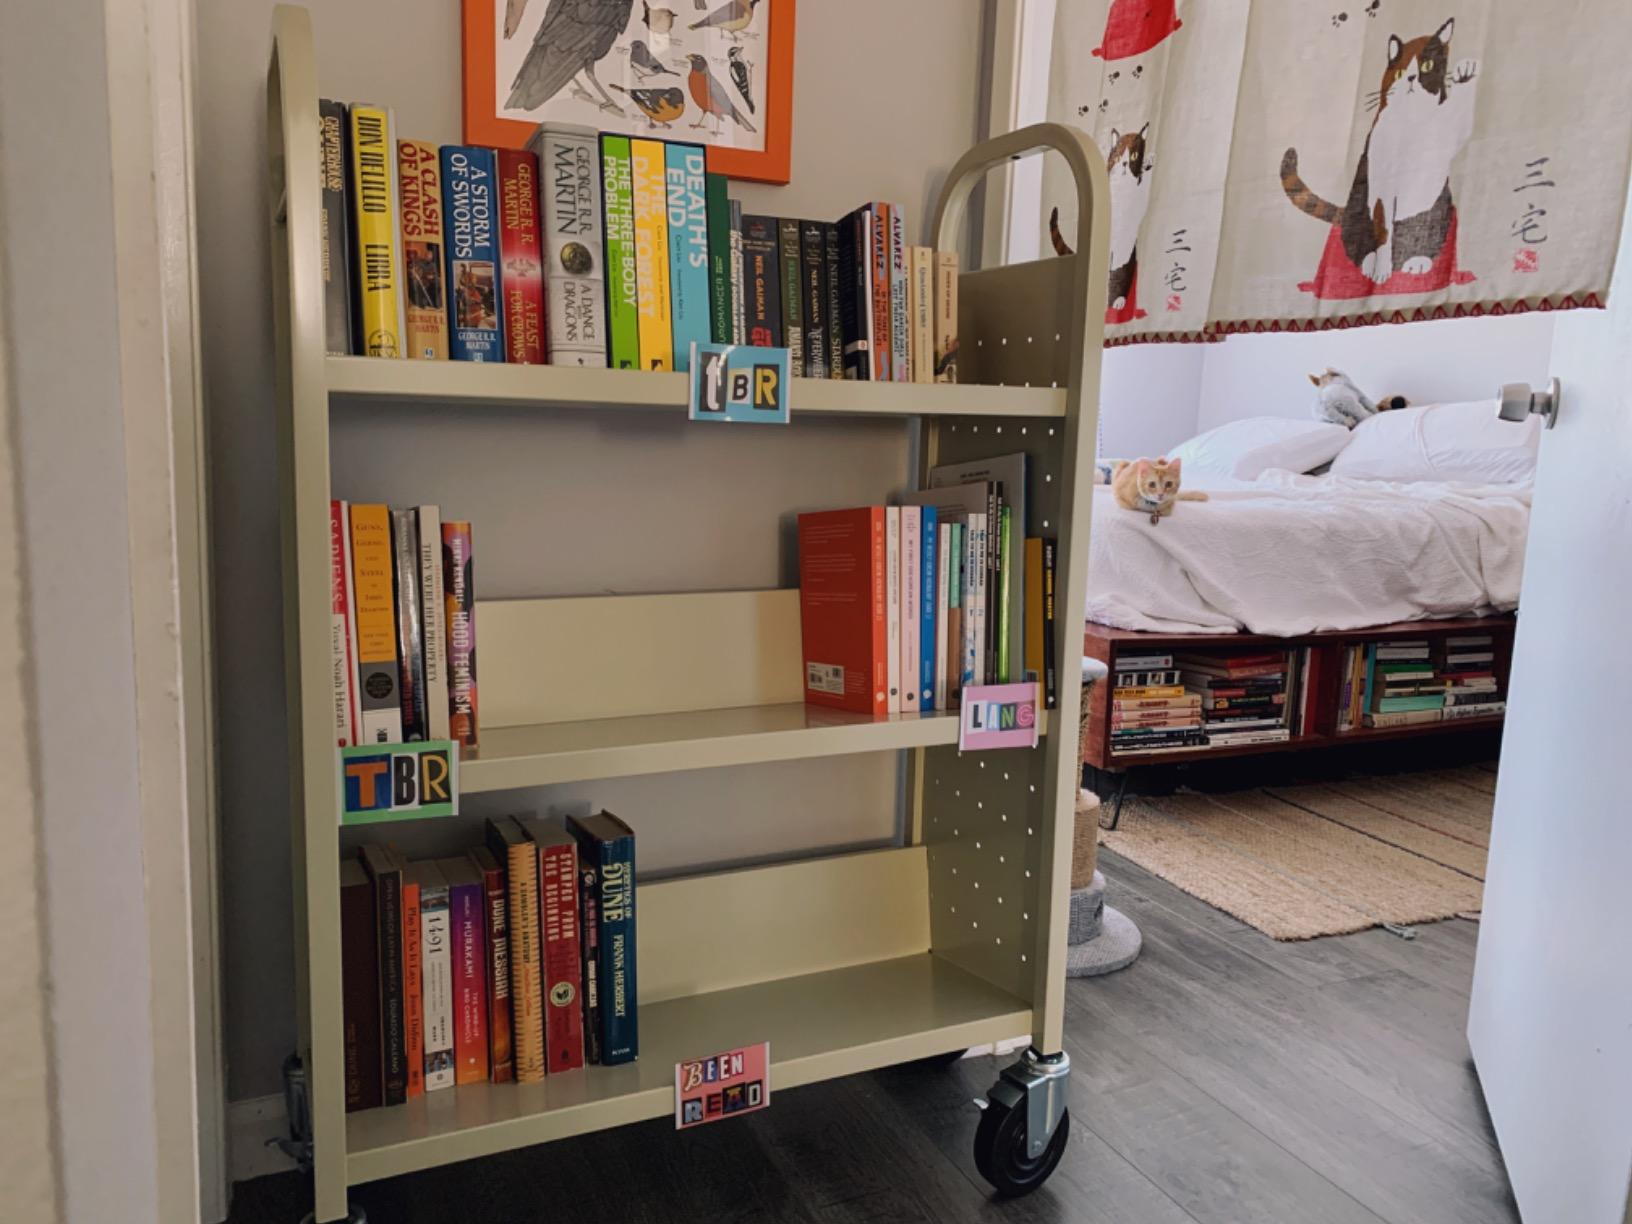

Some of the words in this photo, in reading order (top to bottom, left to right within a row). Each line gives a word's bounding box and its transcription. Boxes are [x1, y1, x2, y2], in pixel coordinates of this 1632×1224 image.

[358, 117, 383, 148] DON
[400, 143, 418, 170] OF
[420, 148, 436, 163] A
[451, 153, 468, 178] OF
[471, 166, 488, 180] A
[617, 158, 632, 190] THE
[360, 152, 387, 213] DELILLO
[518, 163, 533, 215] GEORGE
[554, 143, 577, 235] MARTIN
[575, 146, 591, 205] GEORGE
[632, 155, 651, 221] DARK
[650, 174, 666, 215] THE
[401, 175, 421, 236] KINGS
[421, 168, 439, 235] CLASH
[472, 184, 490, 248] STORM
[504, 178, 519, 229] MARTIN
[604, 155, 619, 240] PROBLEM
[667, 168, 686, 228] END
[685, 155, 707, 268] DEATH'S
[452, 180, 472, 258] SWORDS
[619, 198, 637, 308] THREE-BODY
[875, 216, 885, 270] ALVAREZ
[893, 216, 902, 270] ALVAREZ
[365, 244, 391, 292] LIBRA
[634, 228, 654, 317] FOREST
[755, 256, 764, 274] NEIL
[830, 264, 839, 285] NEIL
[511, 291, 523, 313] FOR
[525, 301, 536, 309] A
[581, 284, 592, 295] A
[755, 278, 765, 320] GAIMAN
[789, 283, 798, 320] GAIMAN
[526, 311, 539, 350] FEAST
[563, 281, 578, 341] DRAGONS
[582, 297, 595, 340] DANCE
[831, 289, 841, 333] GAIMAN
[512, 315, 526, 358] CROWS
[422, 543, 432, 570] THEY
[452, 538, 463, 563] MIKKI
[423, 574, 433, 602] WERE
[453, 566, 465, 604] KENDALL
[424, 607, 435, 628] HER
[452, 611, 470, 648] HOOD
[332, 624, 344, 655] Yuval
[426, 632, 437, 682] PROPERTY
[333, 659, 345, 688] Noah
[454, 652, 472, 714] FEMINISM
[335, 692, 347, 729] Harari
[972, 703, 1034, 729] LING
[345, 754, 448, 808] TBR
[545, 856, 558, 878] THE
[559, 854, 574, 902] STAMPED
[623, 862, 632, 905] HERETICS
[602, 863, 624, 923] DUNE
[406, 907, 417, 926] Play
[492, 900, 505, 933] DUNE
[545, 884, 560, 942] BEGINNING
[561, 910, 575, 940] FROM
[624, 907, 632, 919] OF
[425, 916, 444, 954] 1491
[463, 921, 474, 978] MURAKAMI
[613, 934, 624, 969] FRANK
[493, 938, 509, 1000] MESSIAH
[409, 994, 419, 1016] Joan
[614, 970, 626, 1017] HERBERT
[389, 998, 398, 1034] EDUARDO
[410, 1018, 421, 1050] Didion
[463, 1004, 472, 1044] CHRONICLE
[390, 1036, 399, 1073] GALEANO
[682, 1054, 743, 1092] BEEN
